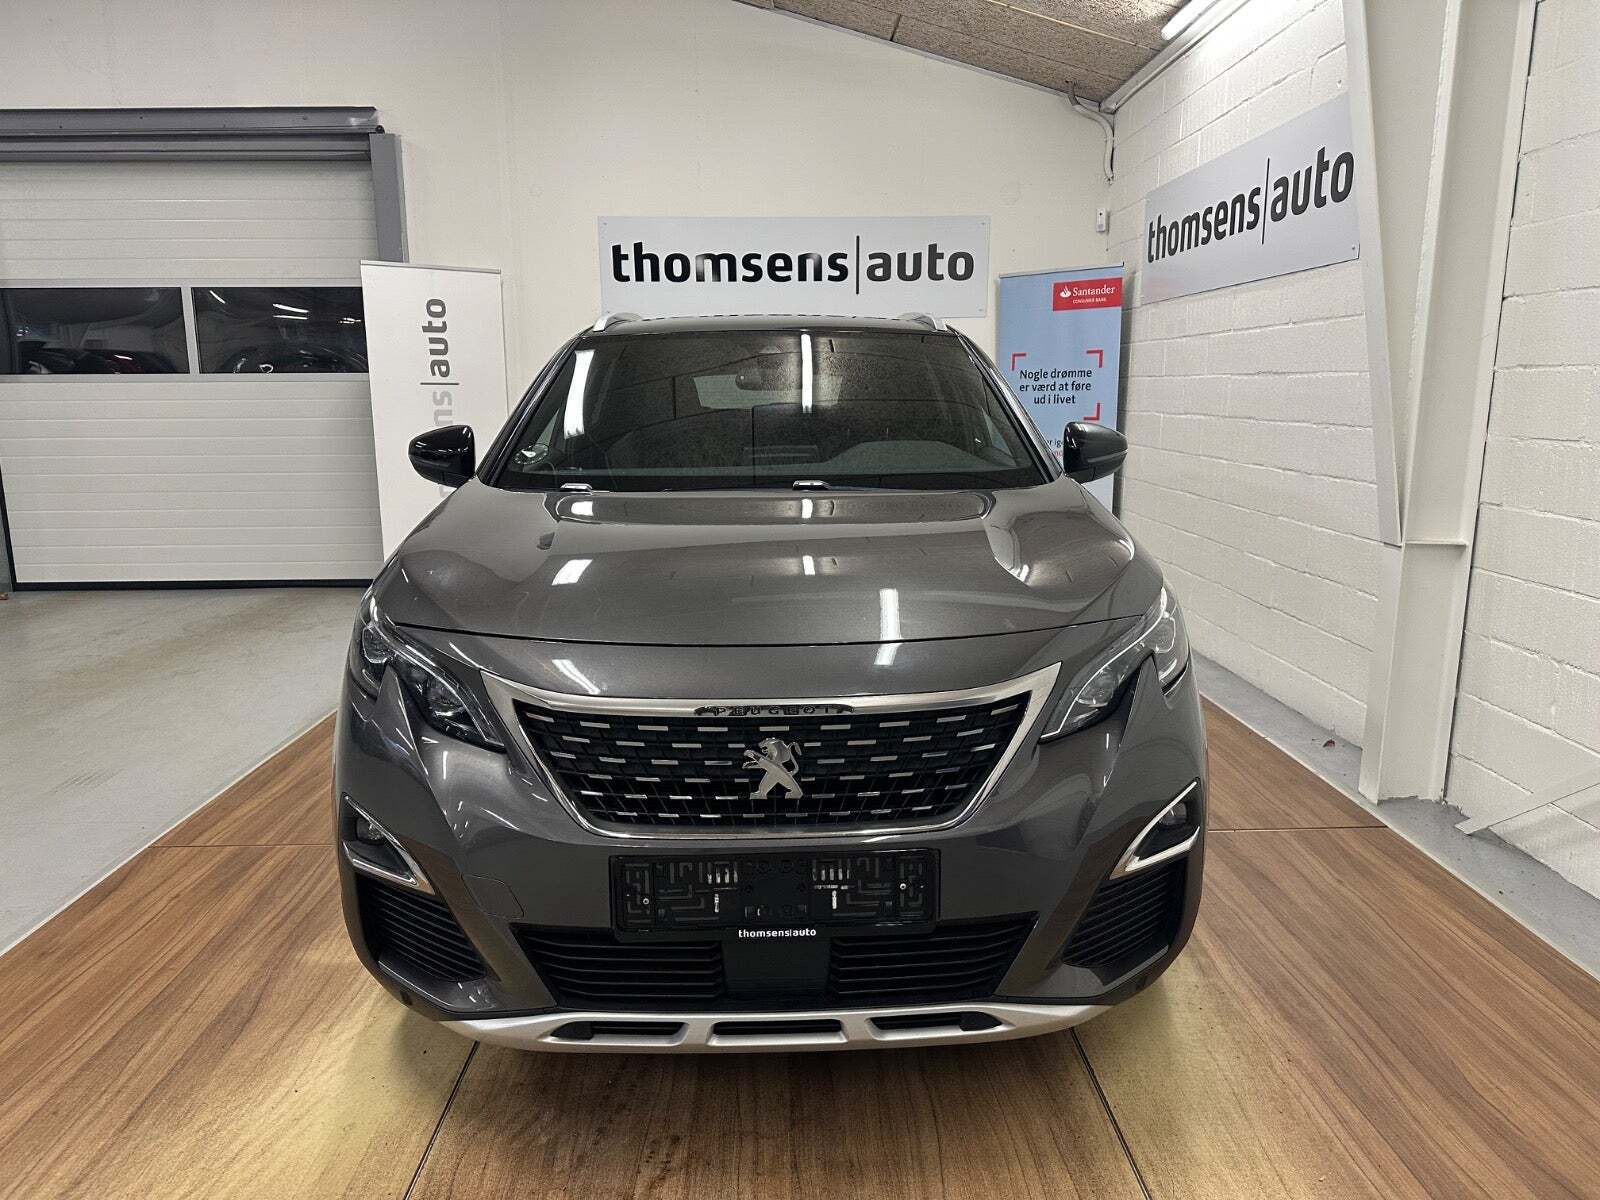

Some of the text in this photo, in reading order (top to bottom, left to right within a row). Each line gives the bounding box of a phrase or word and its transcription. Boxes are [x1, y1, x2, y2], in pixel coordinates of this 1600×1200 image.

[1072, 284, 1116, 297] Santander
[1019, 368, 1092, 381] Nogle drømme
[1031, 381, 1056, 391] værd
[1058, 382, 1068, 391] at
[1071, 381, 1092, 391] føre
[1034, 394, 1046, 404] ud
[1053, 394, 1076, 404] livet
